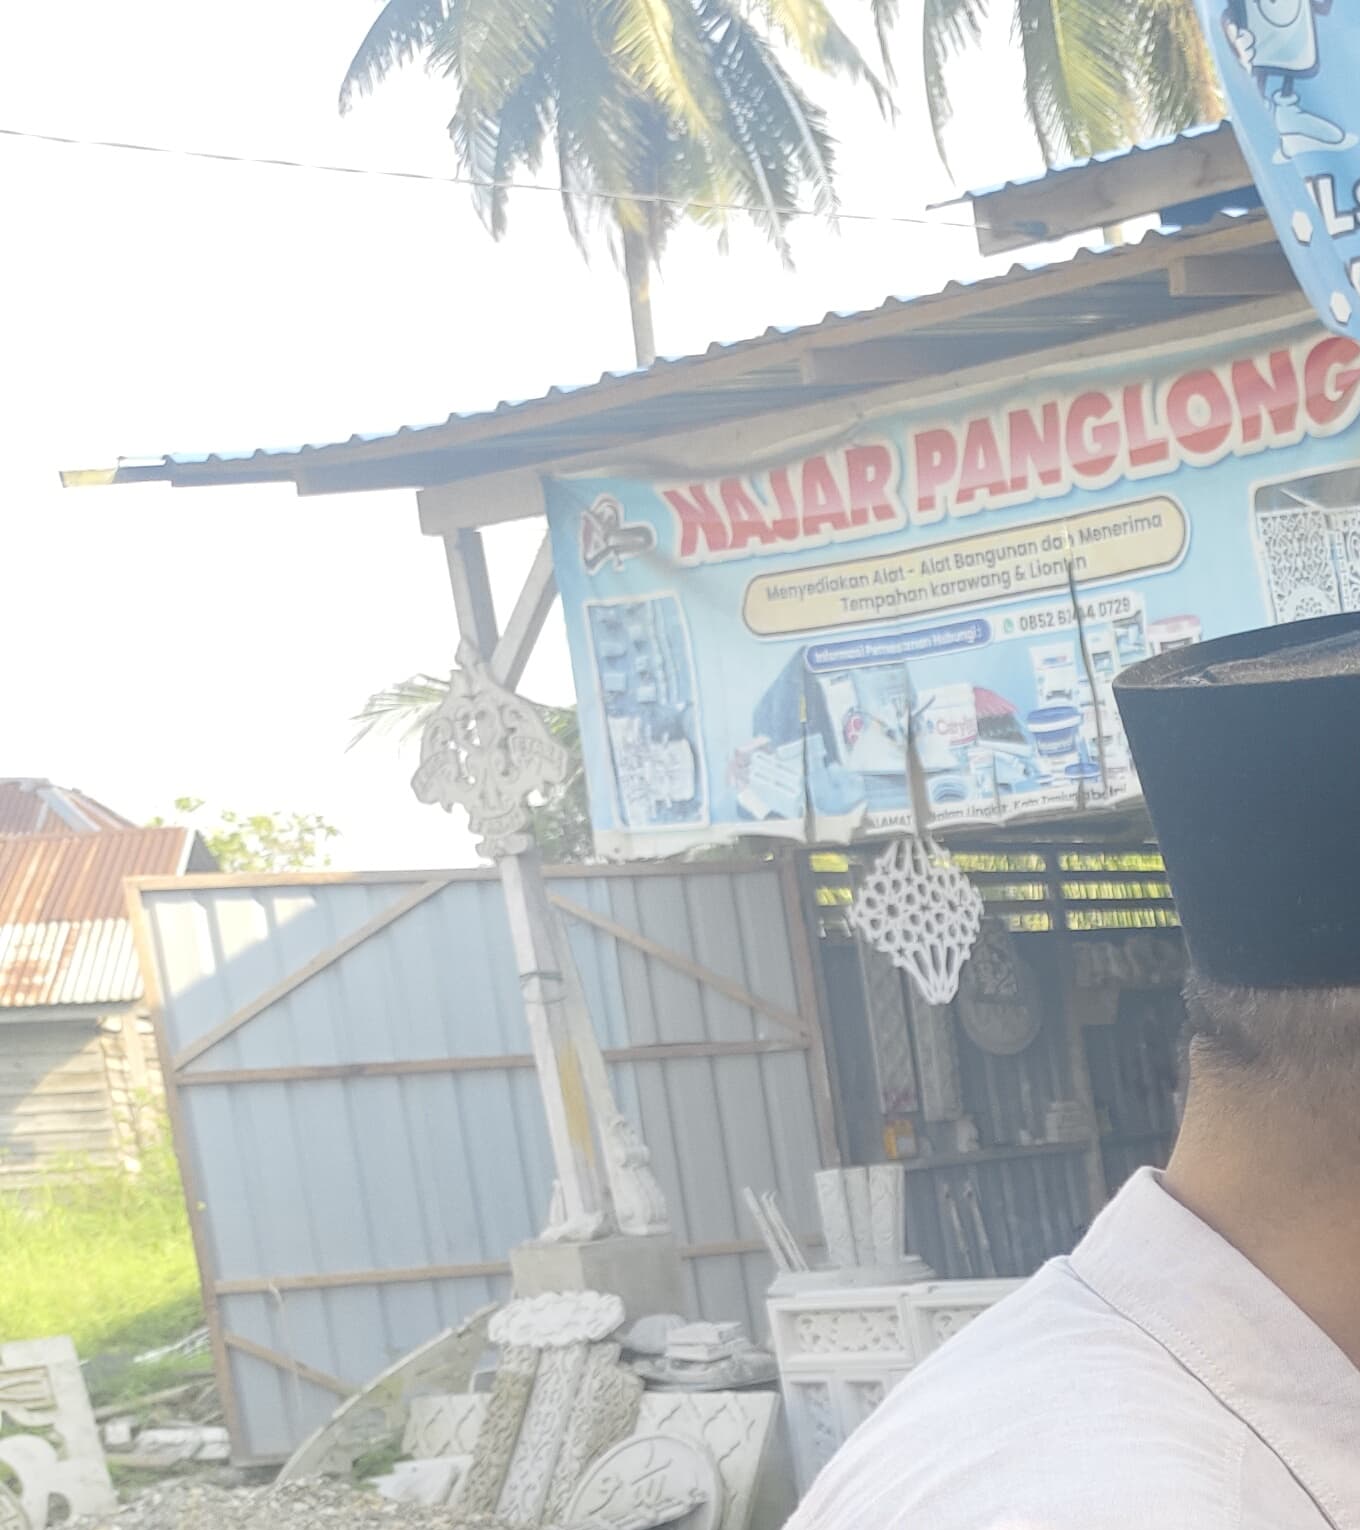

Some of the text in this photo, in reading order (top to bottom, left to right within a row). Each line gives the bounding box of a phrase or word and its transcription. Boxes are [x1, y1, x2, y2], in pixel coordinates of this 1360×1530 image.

[664, 443, 897, 556] NAJAR
[767, 574, 870, 602] Menyediakan
[873, 566, 905, 587] Alat
[921, 555, 951, 577] Alat
[954, 543, 1034, 575] Bangunan
[1079, 512, 1162, 546] Menerima
[841, 587, 928, 615] Tempahan
